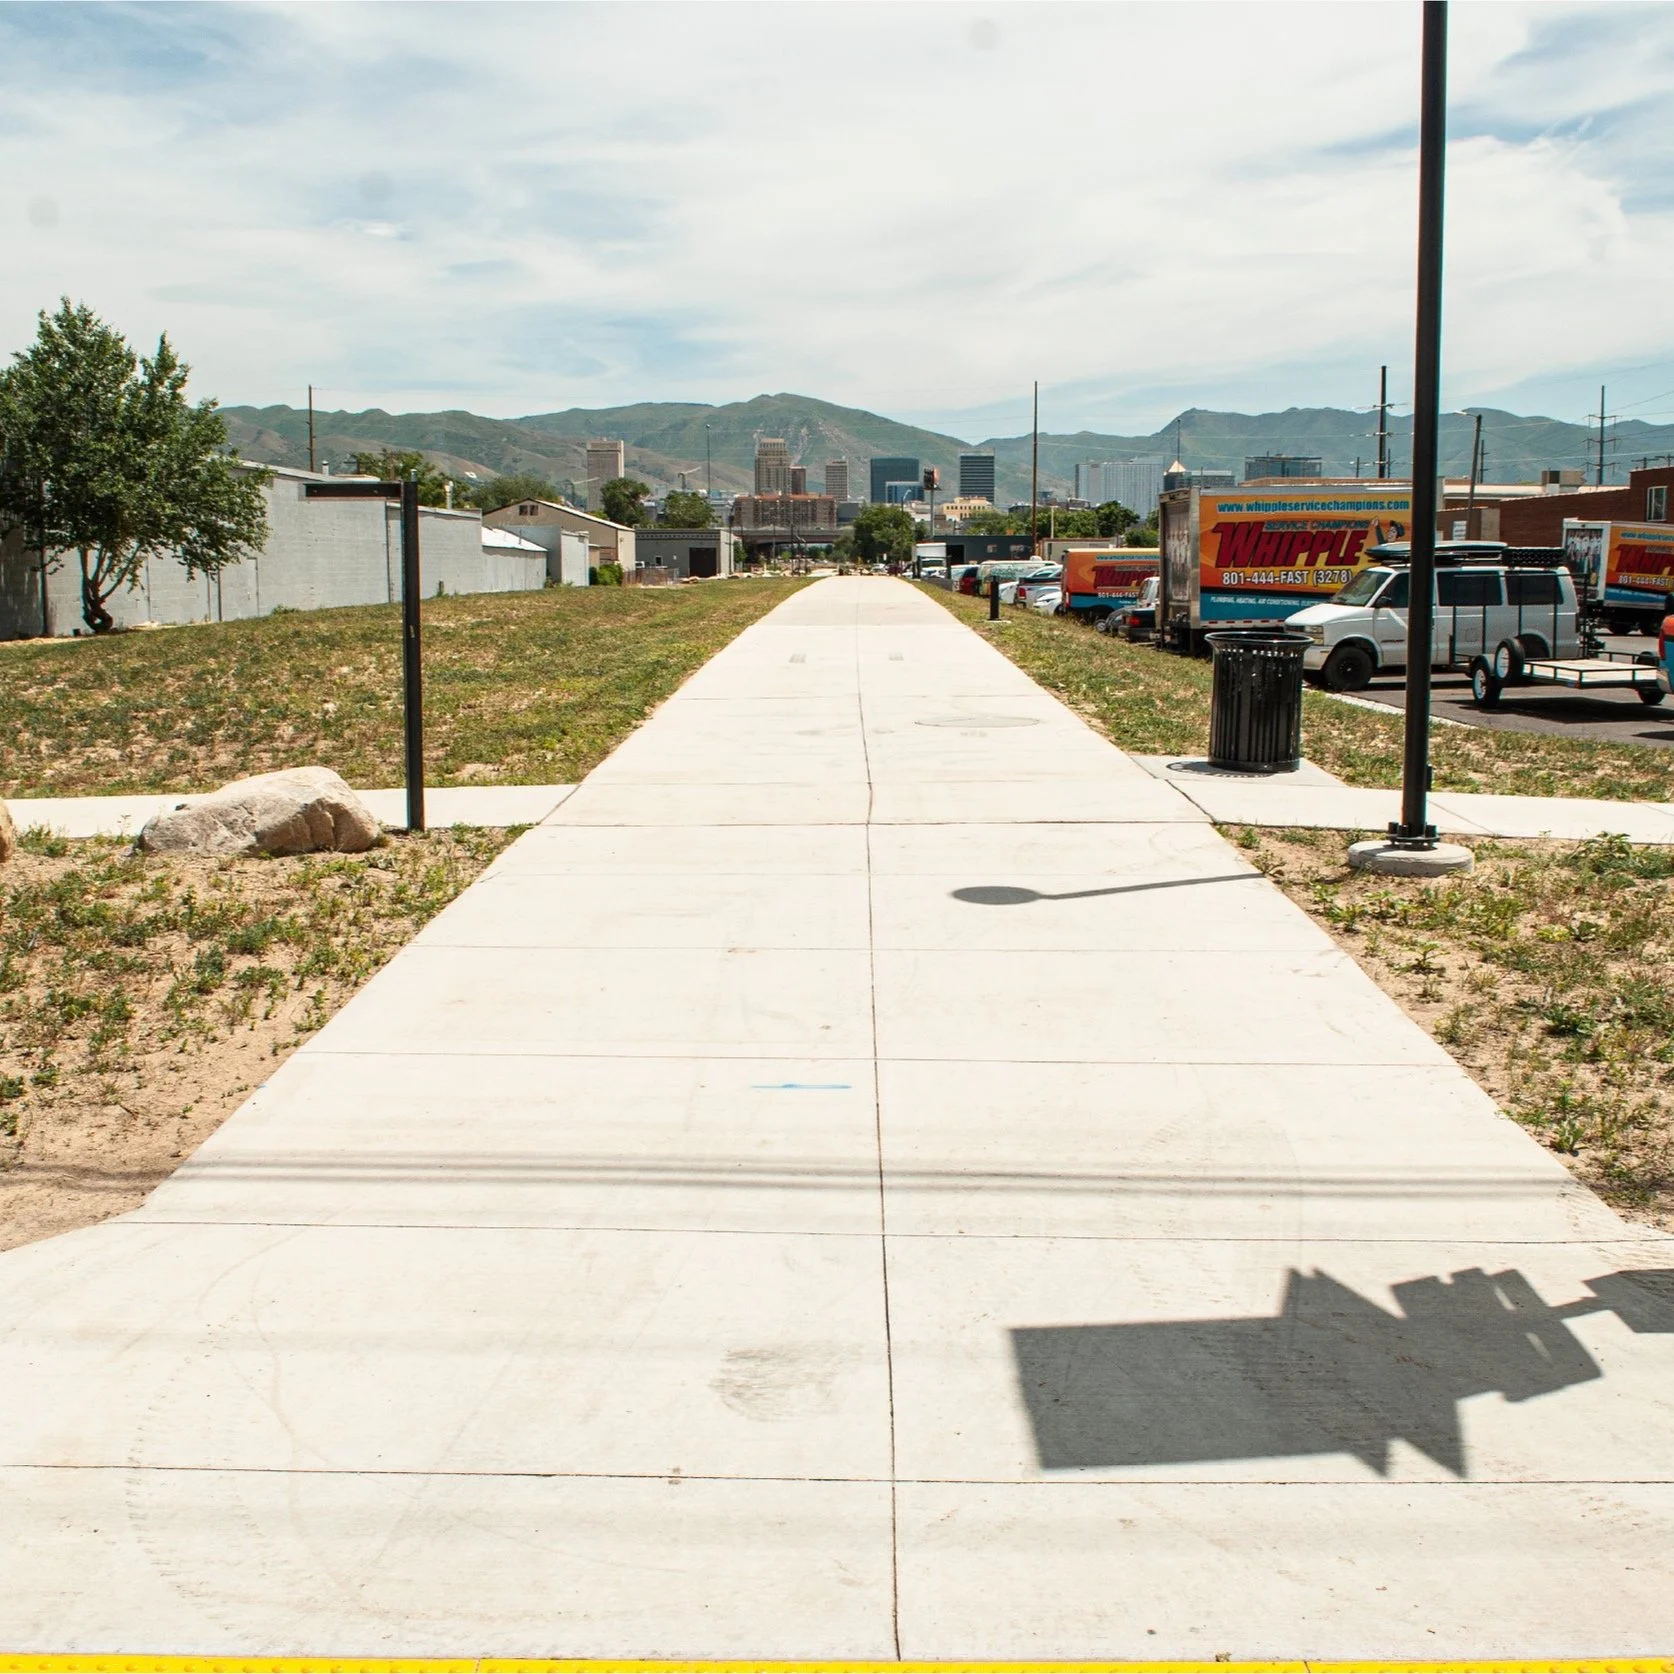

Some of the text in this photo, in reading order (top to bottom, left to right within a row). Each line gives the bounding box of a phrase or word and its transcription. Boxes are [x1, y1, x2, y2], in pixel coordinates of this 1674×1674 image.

[1217, 500, 1410, 513] www.whippleservicechampions.com
[1265, 520, 1370, 531] SERVICE CHAMPIONS
[1212, 521, 1369, 568] WHIPPLE
[1222, 569, 1352, 586] 801-444-FAST (3278)
